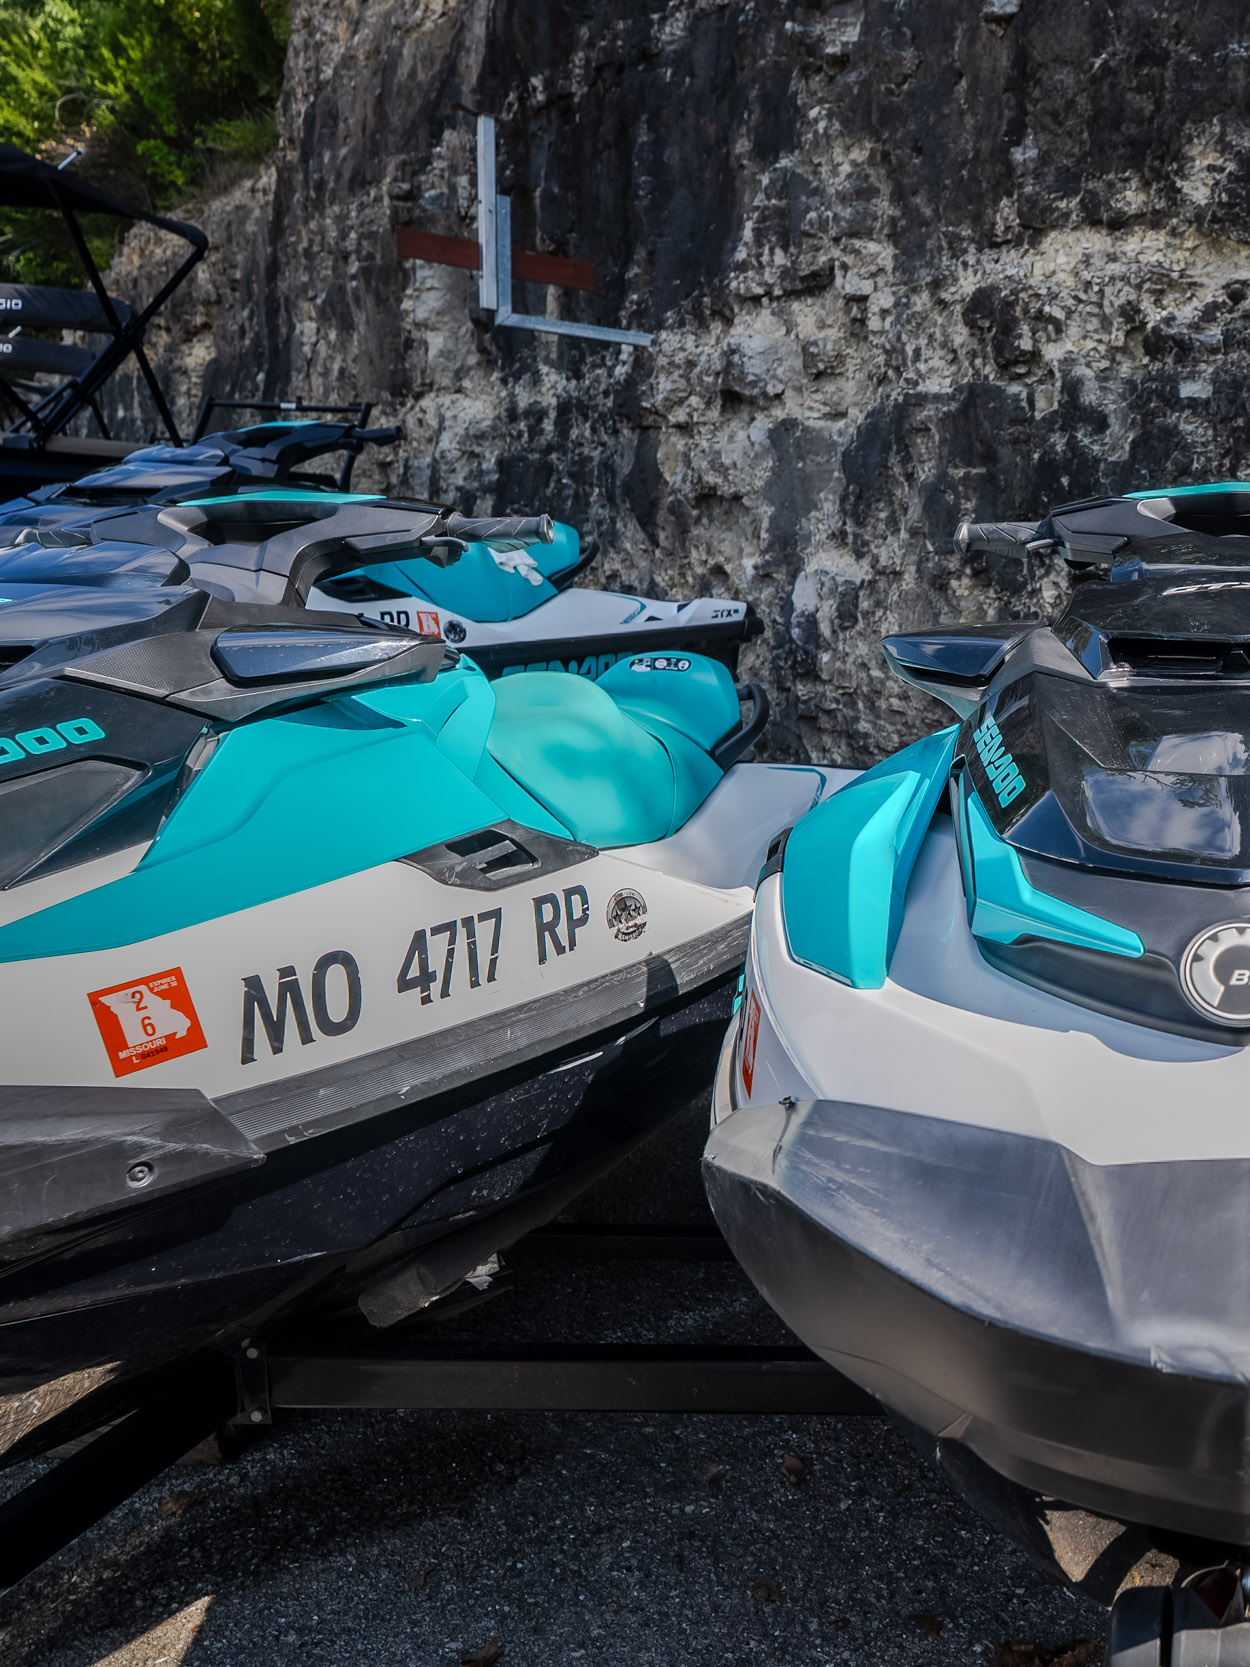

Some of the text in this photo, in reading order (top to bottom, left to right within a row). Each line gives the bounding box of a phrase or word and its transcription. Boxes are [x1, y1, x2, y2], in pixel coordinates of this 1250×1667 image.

[241, 884, 590, 1065] MO 4717 RP
[131, 990, 148, 1012] 2
[141, 1016, 156, 1037] 6
[118, 1037, 167, 1059] MISSOURI
[132, 1056, 141, 1064] L
